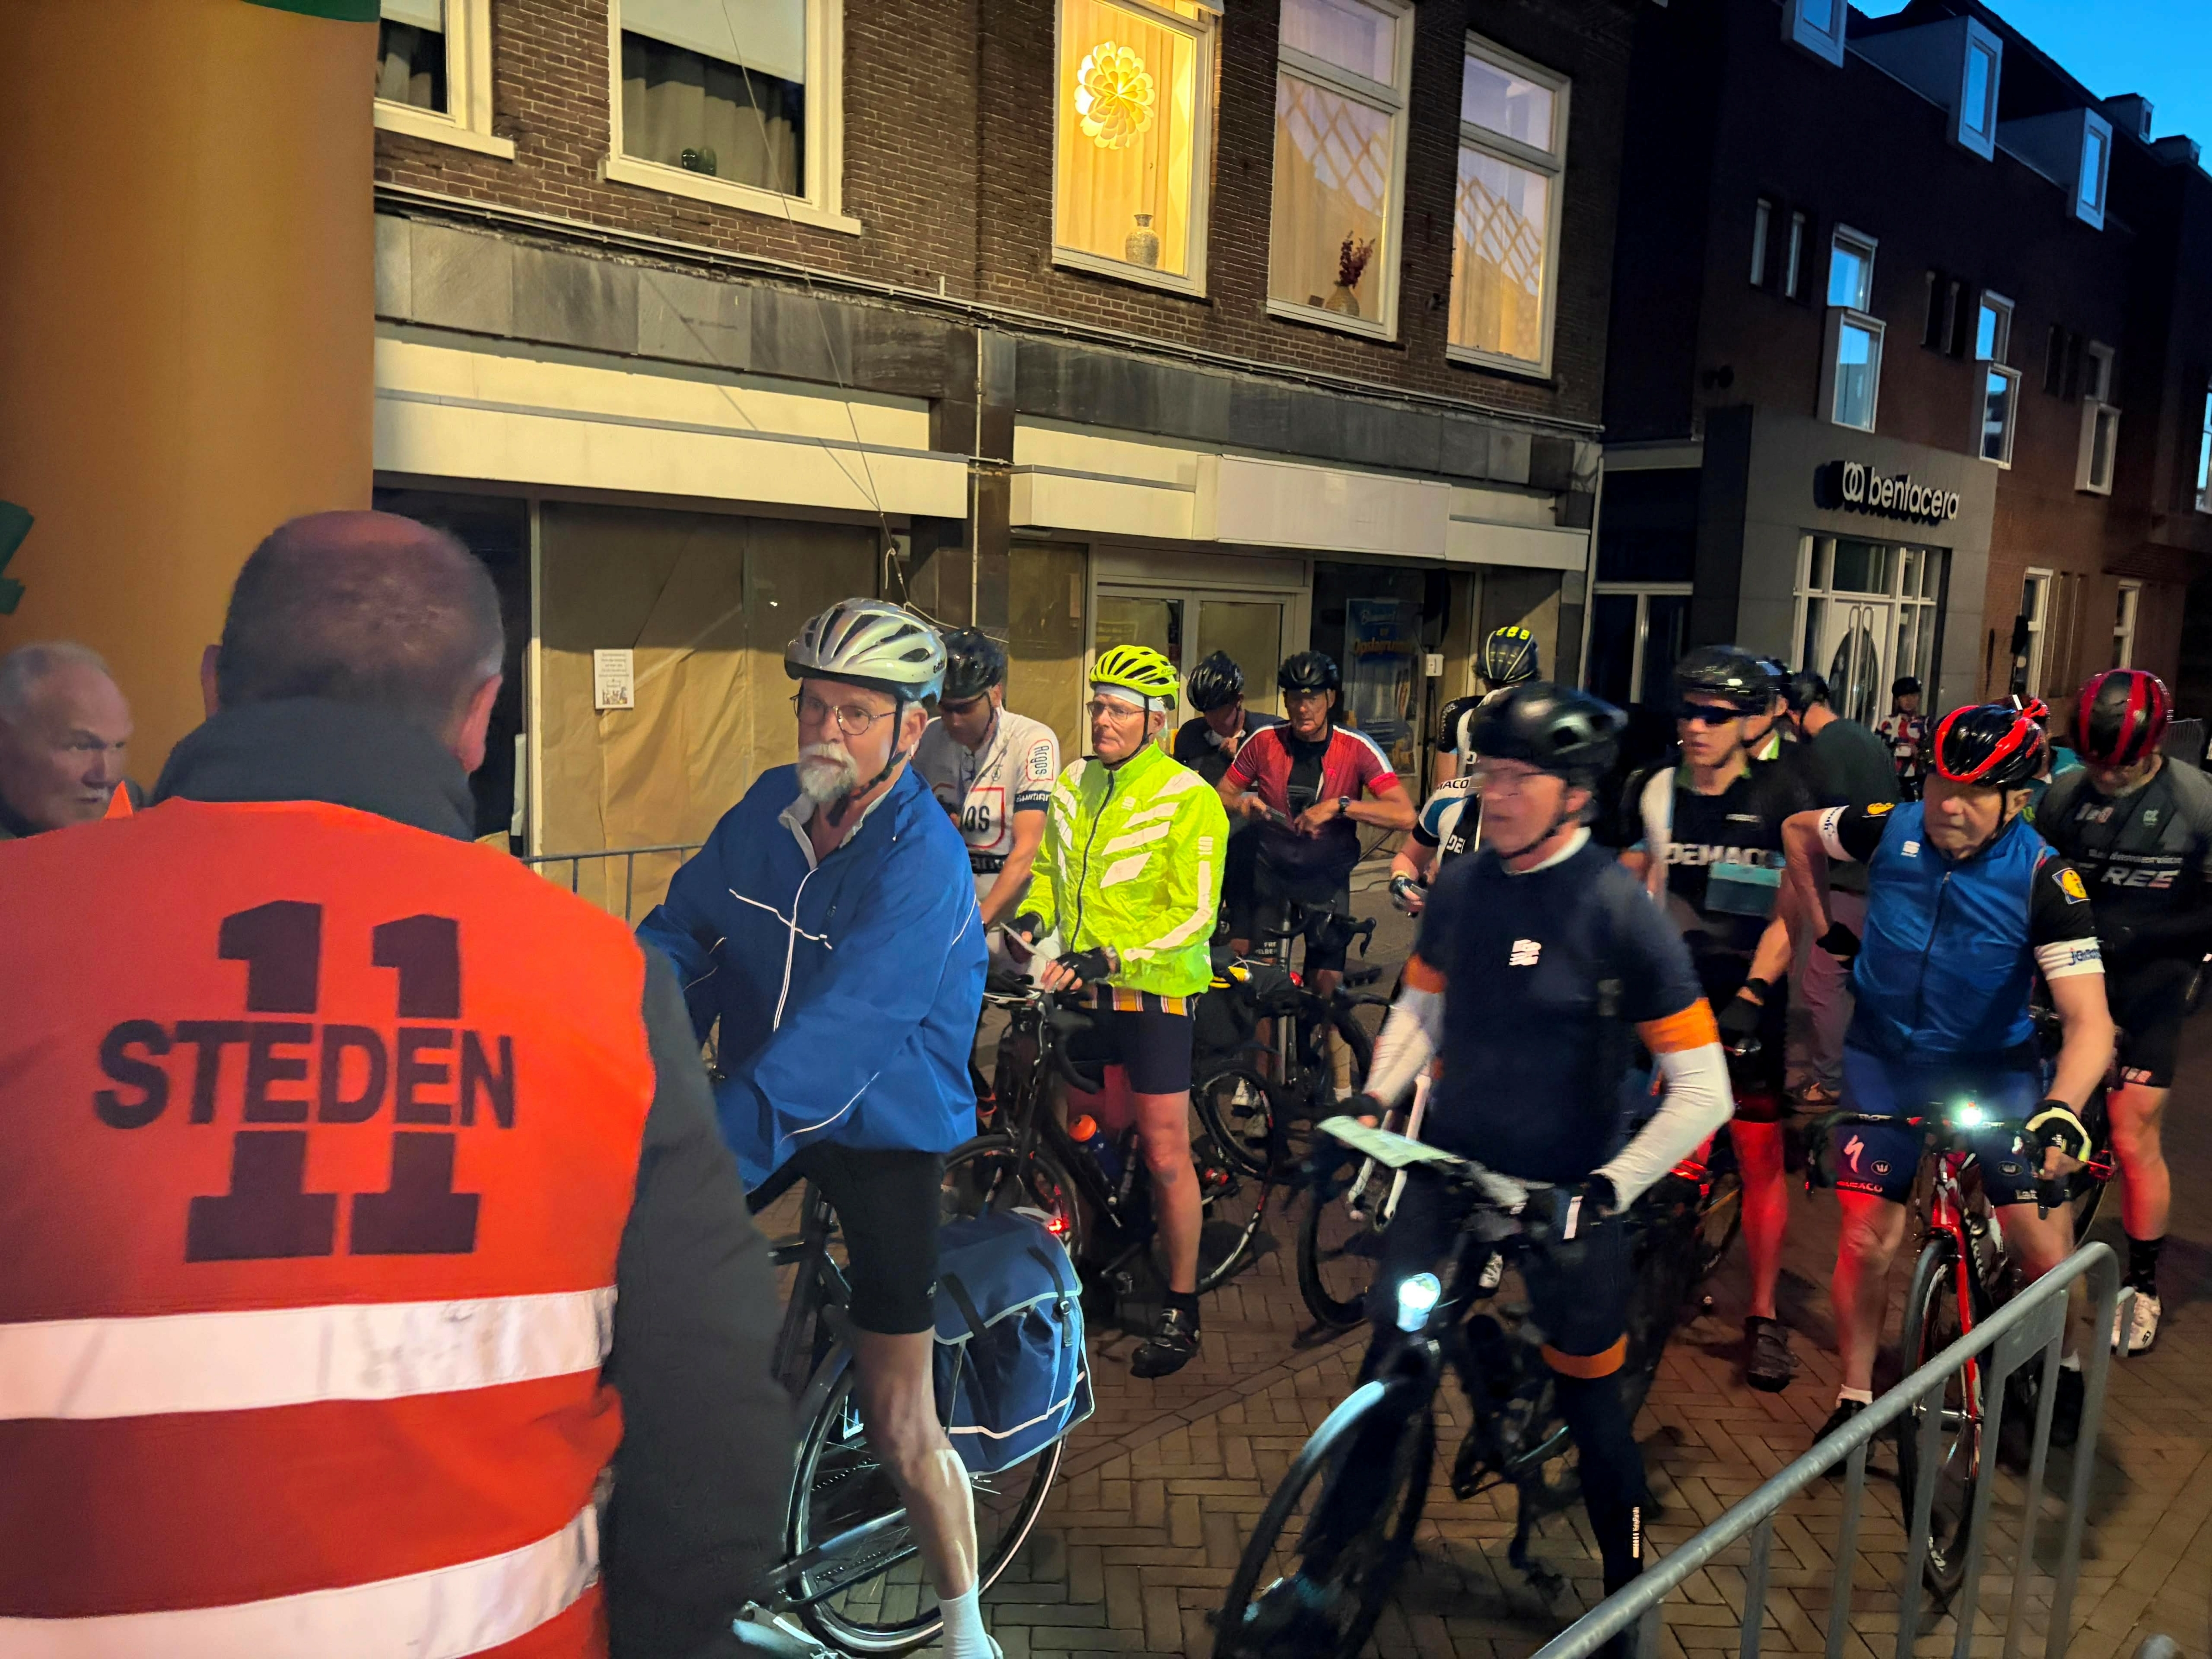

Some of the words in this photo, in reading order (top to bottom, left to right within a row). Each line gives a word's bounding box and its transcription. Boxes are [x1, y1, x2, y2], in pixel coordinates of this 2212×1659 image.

[1869, 467, 1960, 520] bentacera
[1030, 745, 1050, 775] Argos
[93, 1019, 516, 1129] STEDEN
